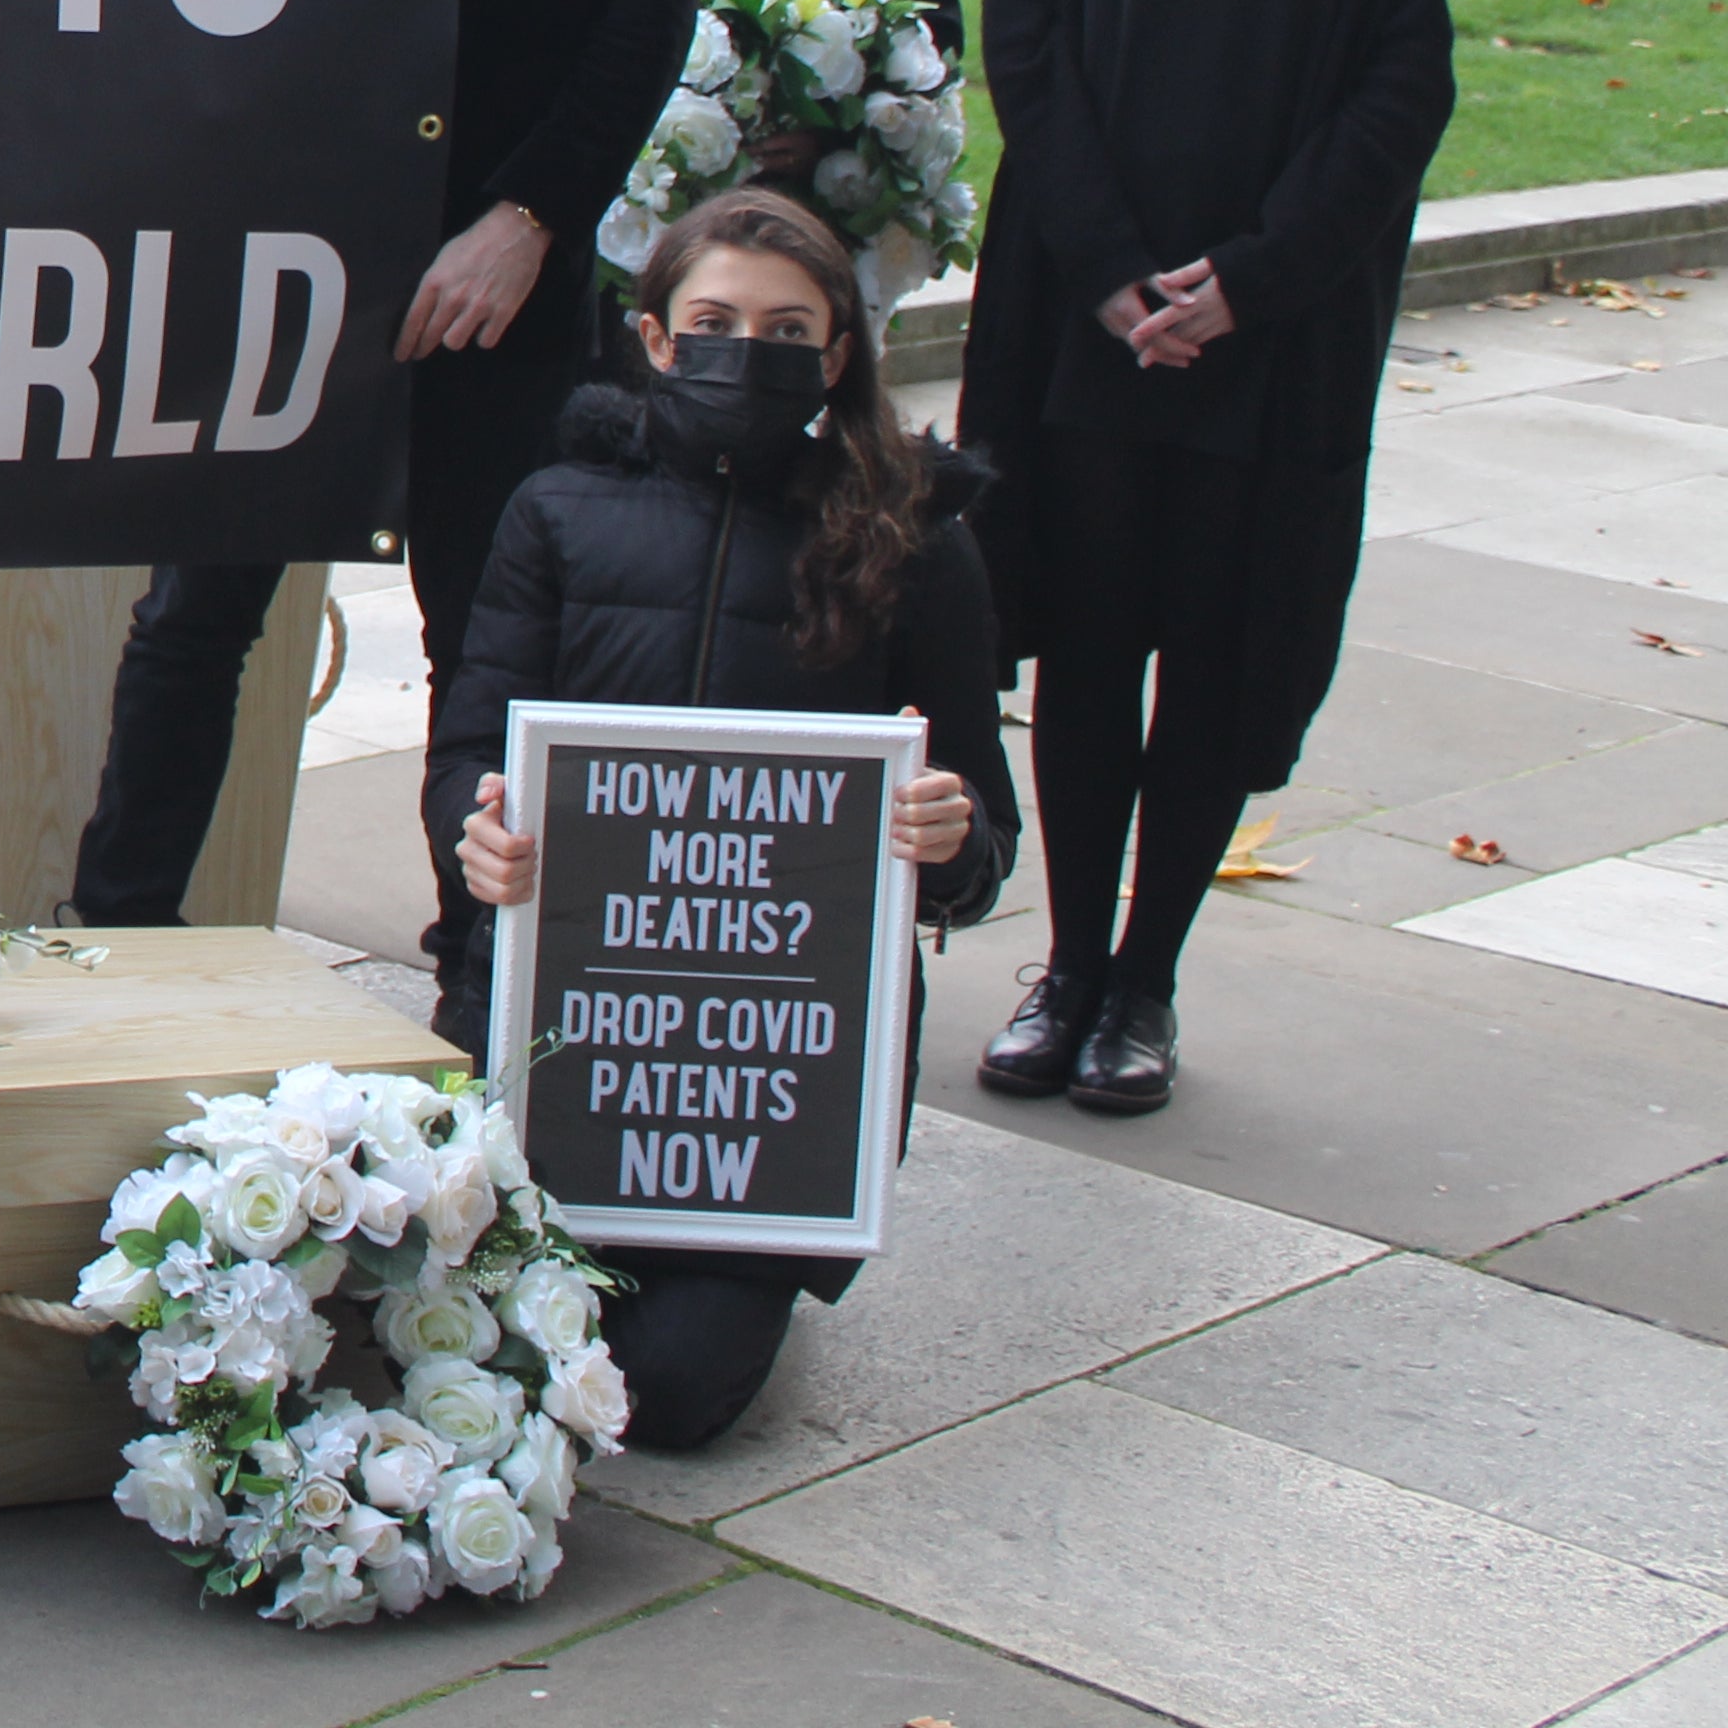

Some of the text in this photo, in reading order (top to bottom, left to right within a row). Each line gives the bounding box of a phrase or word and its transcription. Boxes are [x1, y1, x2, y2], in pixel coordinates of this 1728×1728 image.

[587, 761, 846, 824] HOW MANY
[648, 830, 774, 888] MORE
[604, 894, 812, 954] DEATHS?
[562, 990, 835, 1054] DROP COVID
[591, 1060, 798, 1122] PATENTS
[620, 1130, 760, 1202] NOW
